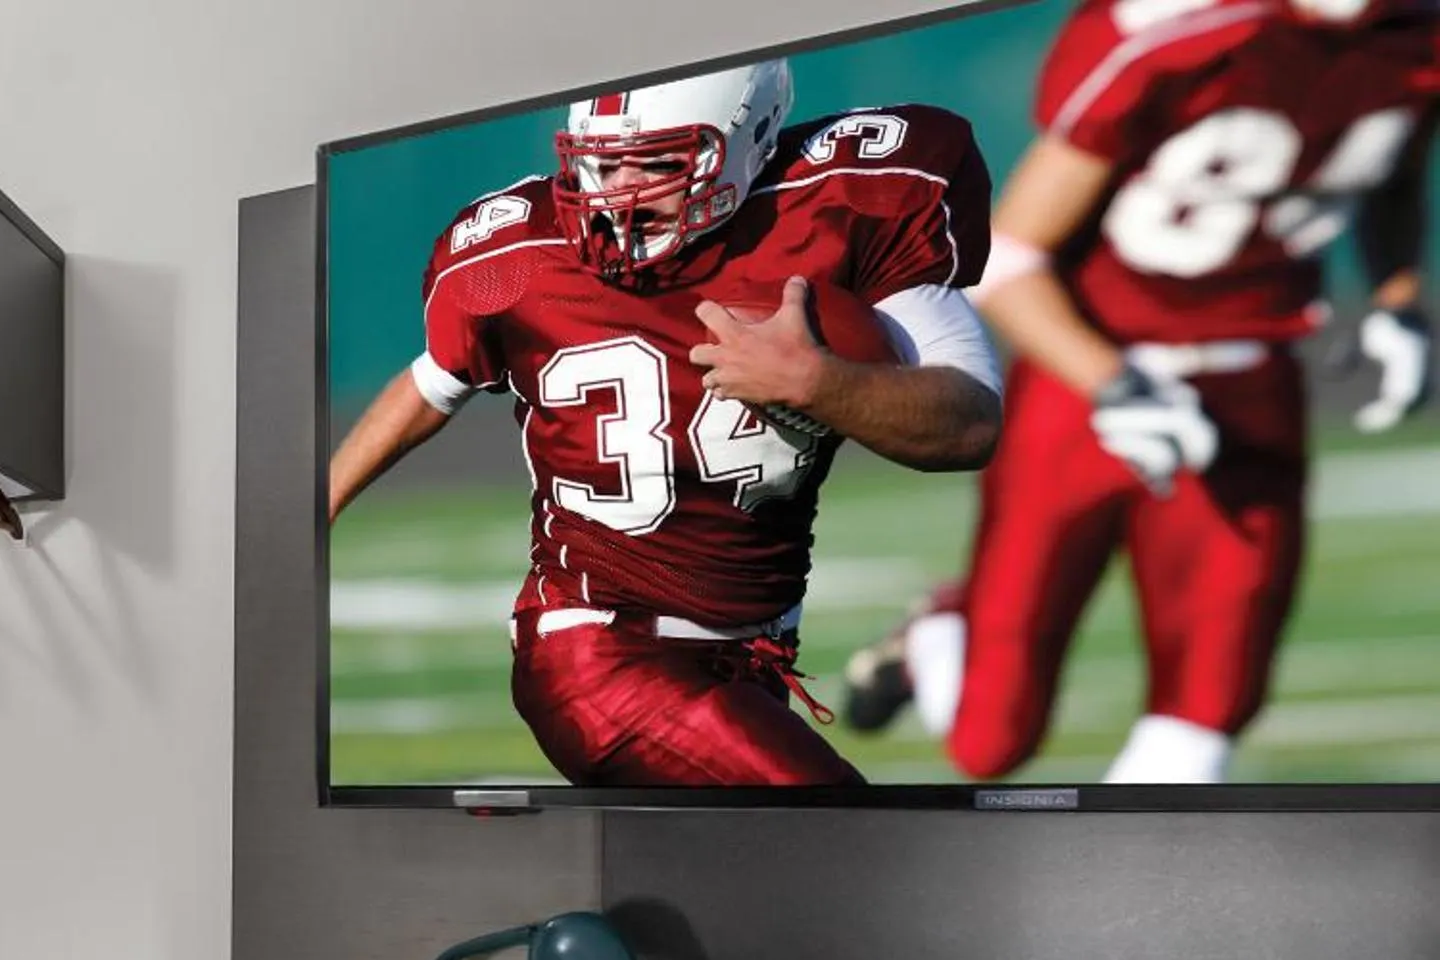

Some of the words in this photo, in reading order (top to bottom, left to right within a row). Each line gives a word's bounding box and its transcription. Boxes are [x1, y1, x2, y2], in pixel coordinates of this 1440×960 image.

[799, 113, 908, 165] 3
[450, 195, 532, 254] 4
[538, 335, 816, 536] 34
[985, 795, 1066, 806] INSIGNIA
